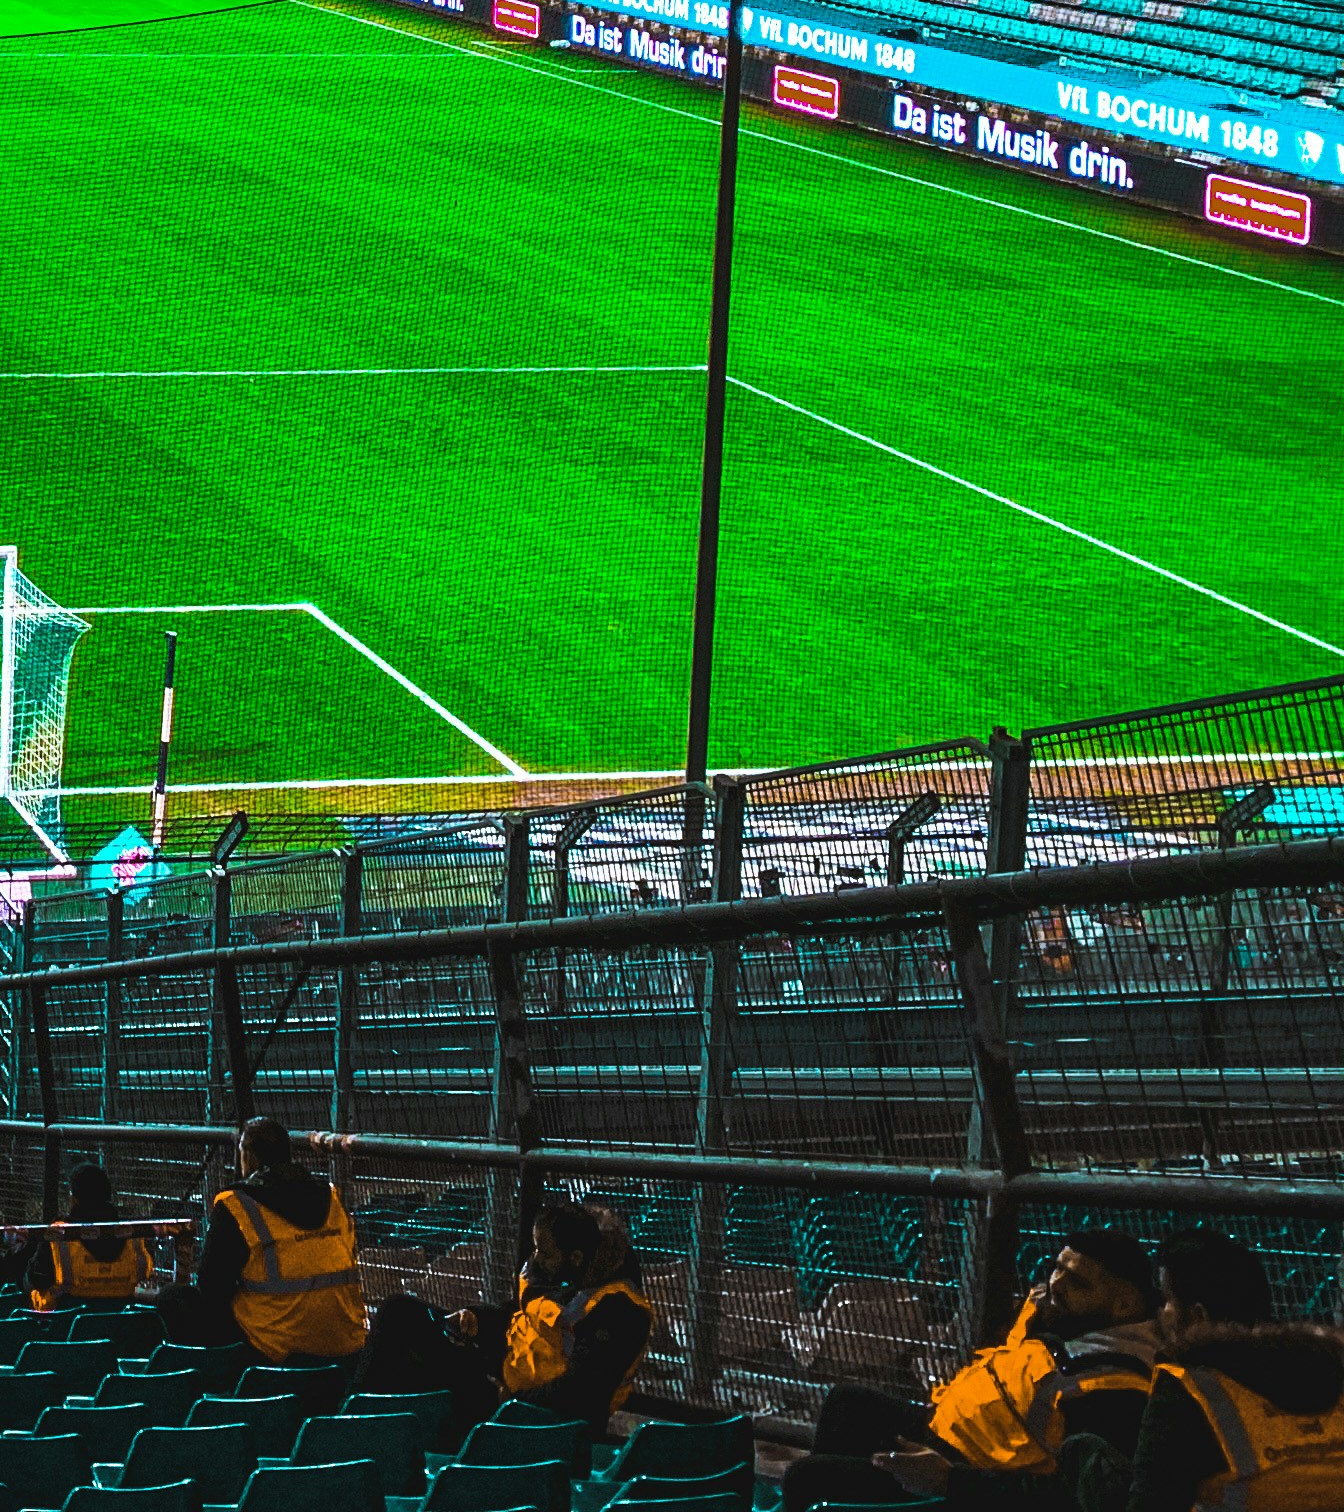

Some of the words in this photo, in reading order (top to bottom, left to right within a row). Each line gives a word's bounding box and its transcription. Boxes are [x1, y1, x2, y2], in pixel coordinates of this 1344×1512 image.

[572, 15, 596, 47] Da
[599, 21, 623, 54] ist
[629, 29, 686, 71] Musik
[694, 2, 730, 30] 1848
[760, 16, 784, 43] VfL
[787, 21, 868, 63] BOCHUM
[874, 42, 916, 73] 1848
[893, 95, 927, 135] Da
[932, 105, 967, 144] ist
[978, 116, 1058, 169] Musik
[1069, 141, 1134, 188] drin.
[1057, 82, 1089, 116] VfL
[1097, 90, 1209, 143] BOCHUM
[1220, 120, 1279, 158] 1848
